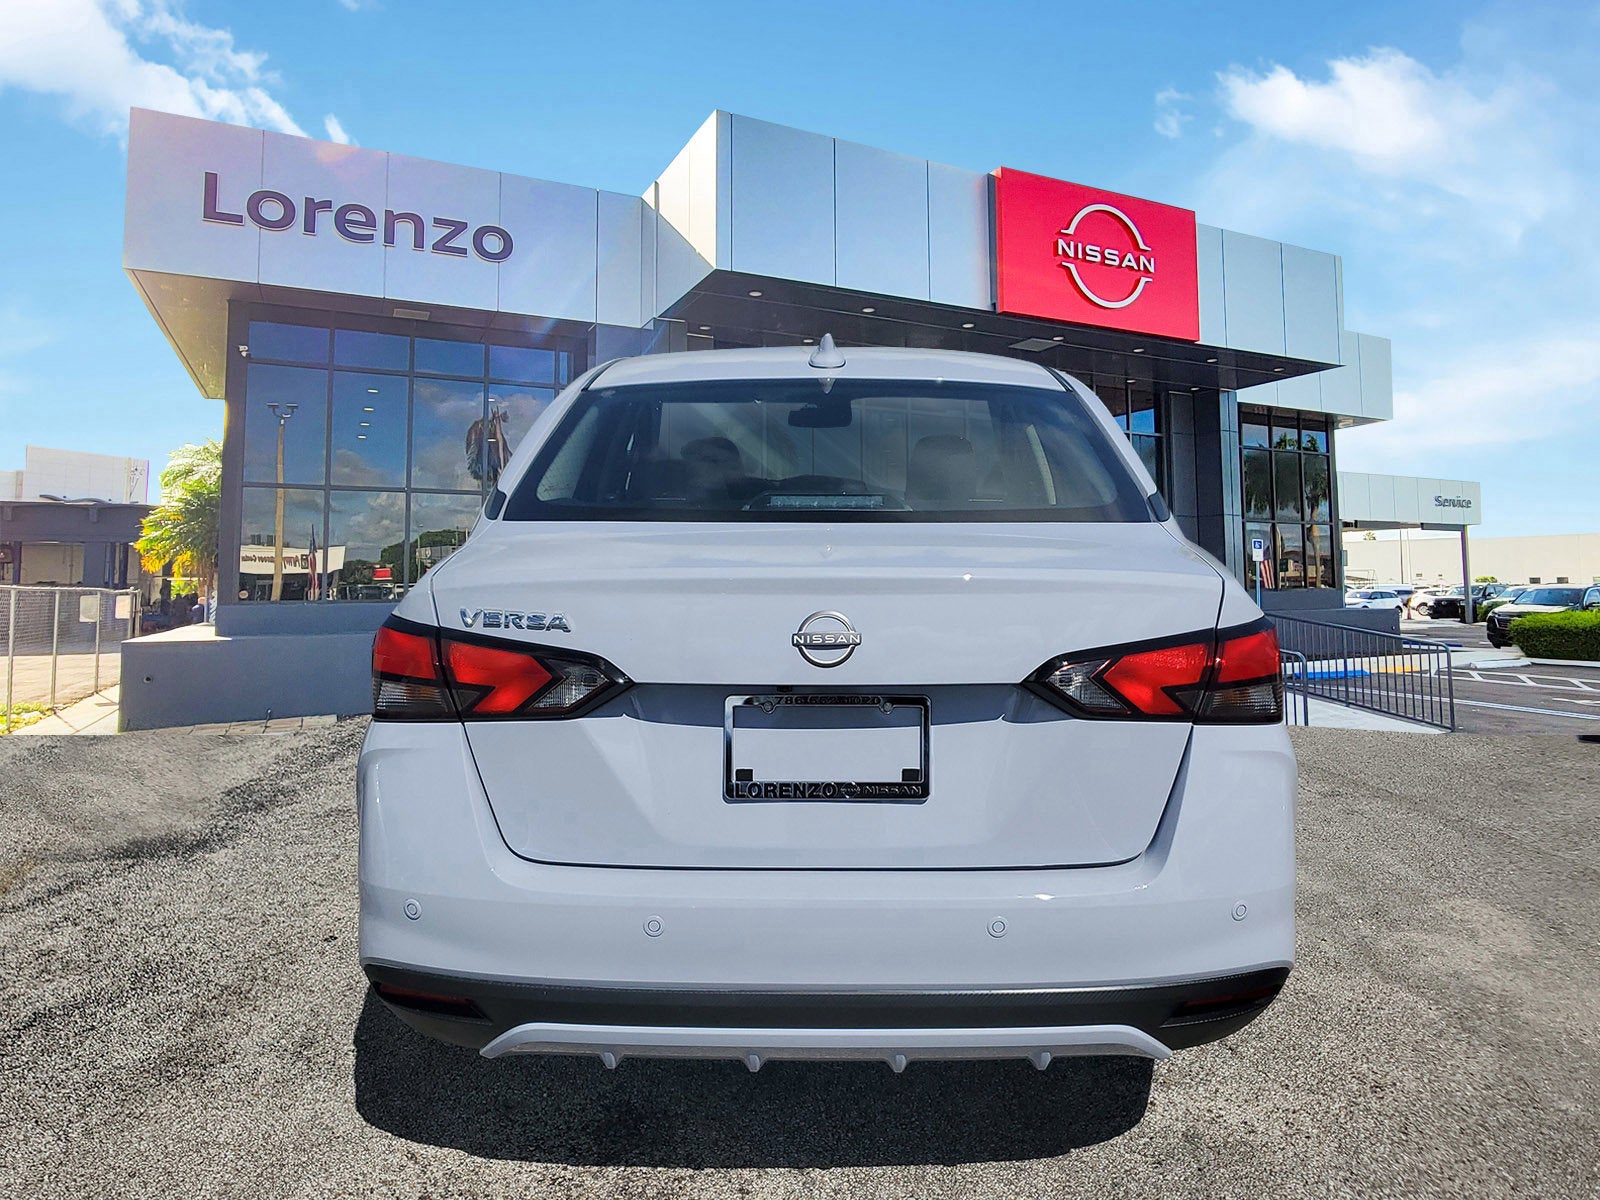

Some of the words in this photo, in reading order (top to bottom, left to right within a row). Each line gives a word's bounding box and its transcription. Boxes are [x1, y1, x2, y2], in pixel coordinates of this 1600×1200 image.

[202, 171, 515, 263] Lorenzo
[1057, 238, 1155, 273] NISSAN
[1434, 495, 1472, 508] Service
[459, 607, 572, 633] VERSA
[793, 634, 861, 644] NISSAN
[735, 782, 838, 799] LORENZO
[864, 785, 922, 796] NISSAN
